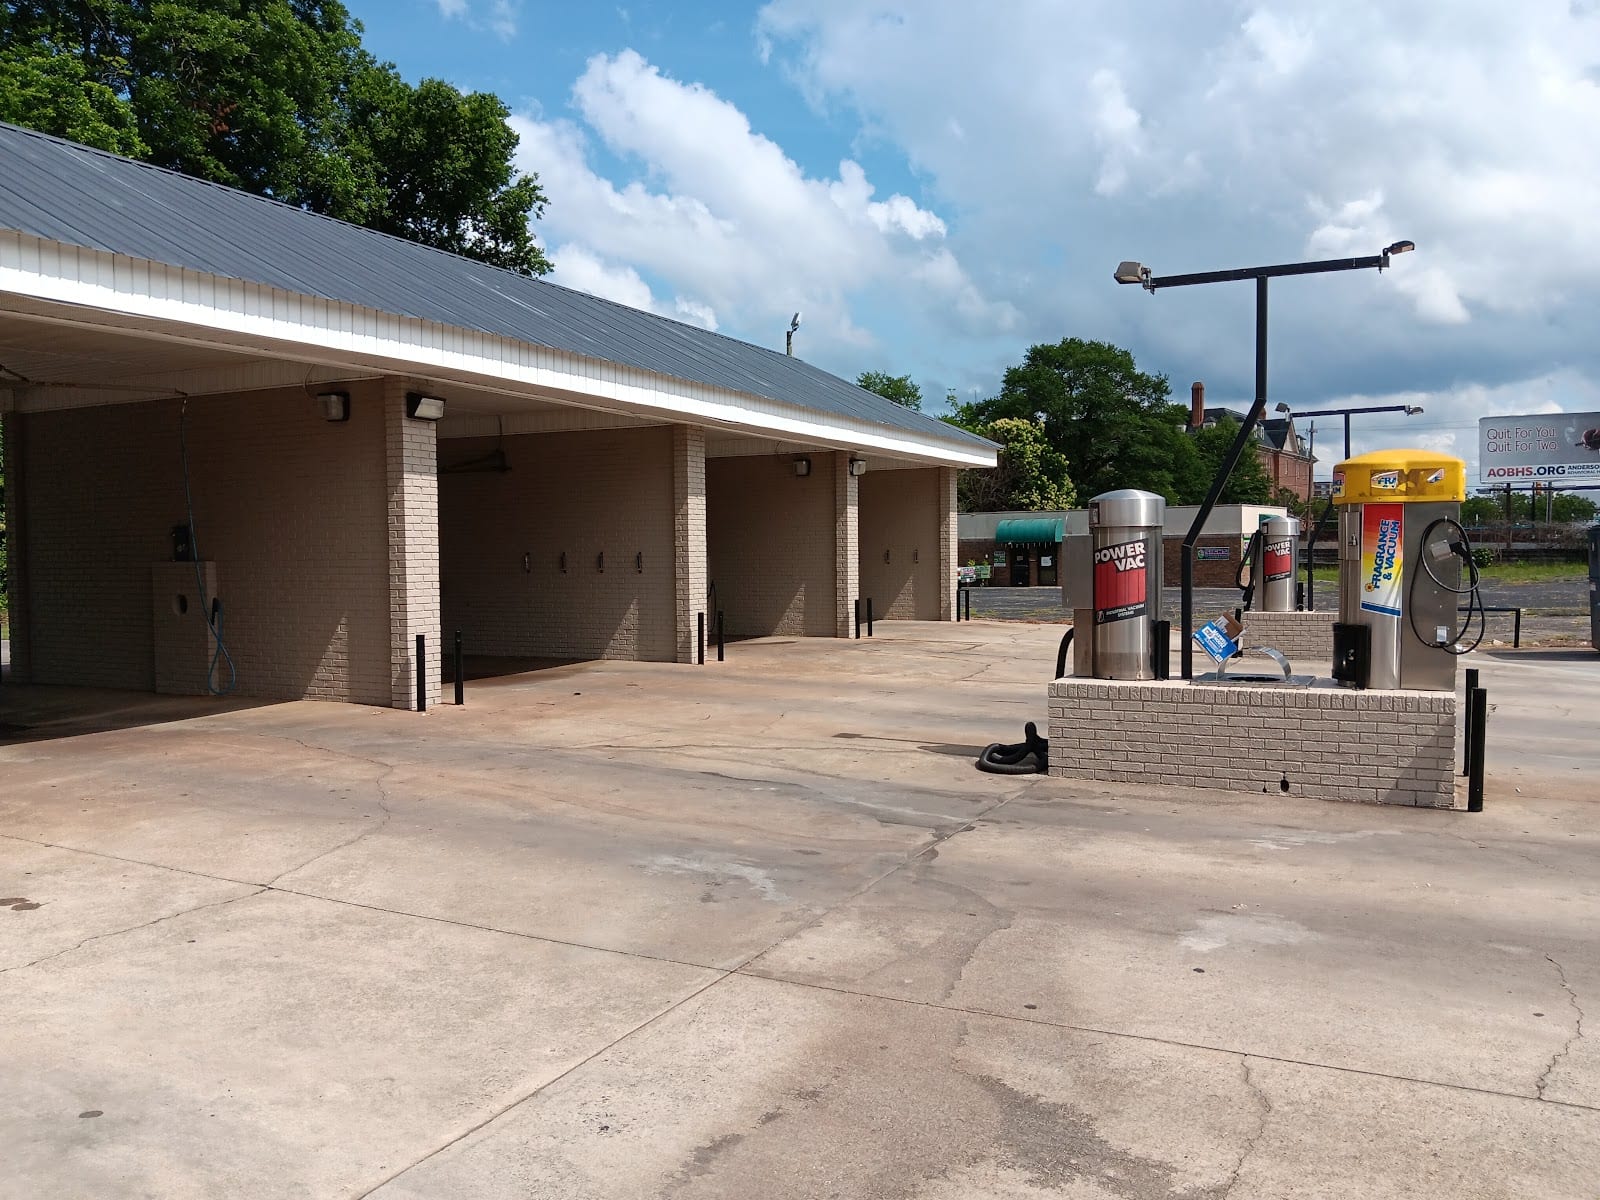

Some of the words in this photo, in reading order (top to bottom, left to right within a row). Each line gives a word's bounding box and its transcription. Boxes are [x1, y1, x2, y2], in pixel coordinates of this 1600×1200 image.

[1487, 428, 1511, 440] Quit
[1515, 427, 1532, 438] For
[1487, 441, 1511, 453] Quit
[1515, 440, 1532, 451] For
[1487, 465, 1566, 477] AOBHS.ORG
[1263, 541, 1291, 553] POWER
[1384, 520, 1400, 570] VACUUM
[1094, 541, 1146, 565] POWER
[1275, 547, 1291, 557] VAC
[1371, 519, 1390, 589] FRAGRANCE
[1113, 554, 1145, 572] VAC
[1382, 572, 1393, 581] &
